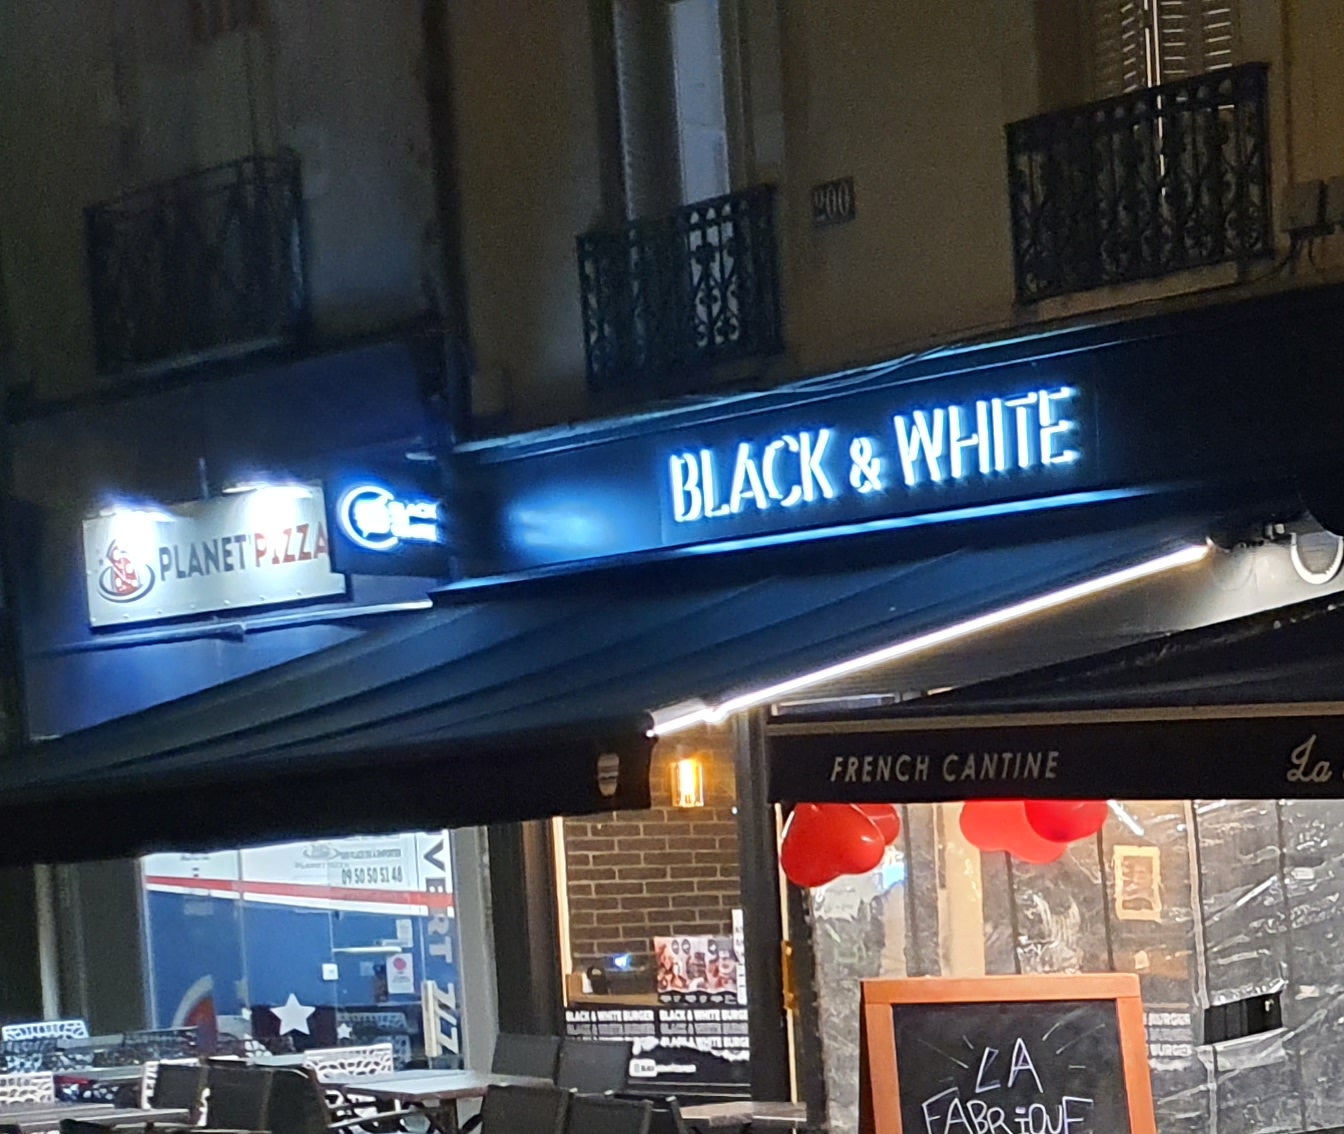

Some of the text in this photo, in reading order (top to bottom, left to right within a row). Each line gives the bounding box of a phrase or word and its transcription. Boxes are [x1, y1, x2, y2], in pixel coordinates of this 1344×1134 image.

[668, 385, 1080, 522] BLACK & WHITE
[159, 533, 246, 582] PLANET
[254, 520, 329, 569] PIZZA
[830, 750, 1060, 783] FRENCH CANTINE
[1286, 733, 1333, 783] La
[422, 834, 454, 963] VERT
[974, 1037, 1045, 1095] LA
